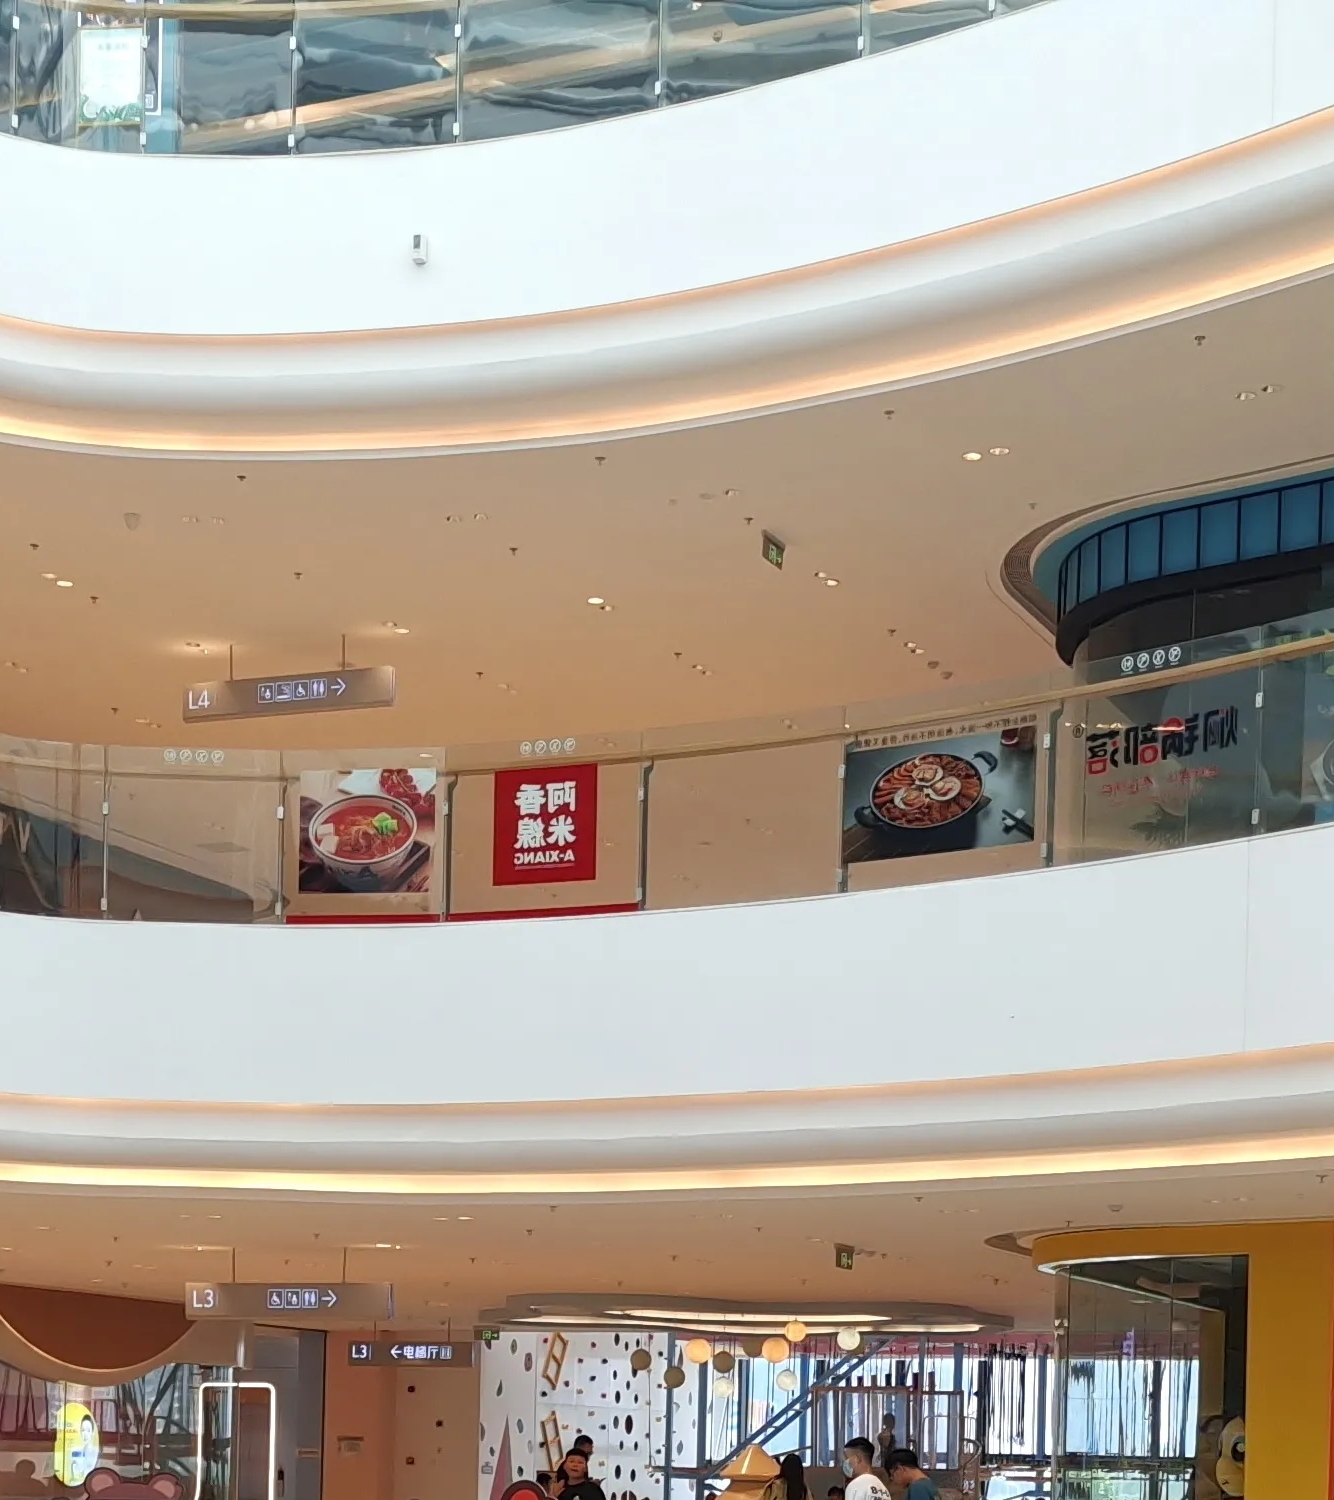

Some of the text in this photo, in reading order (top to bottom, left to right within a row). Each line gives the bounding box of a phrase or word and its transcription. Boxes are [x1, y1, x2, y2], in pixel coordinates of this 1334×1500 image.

[187, 689, 211, 711] L4
[192, 1289, 215, 1309] L3
[351, 1344, 368, 1360] L3
